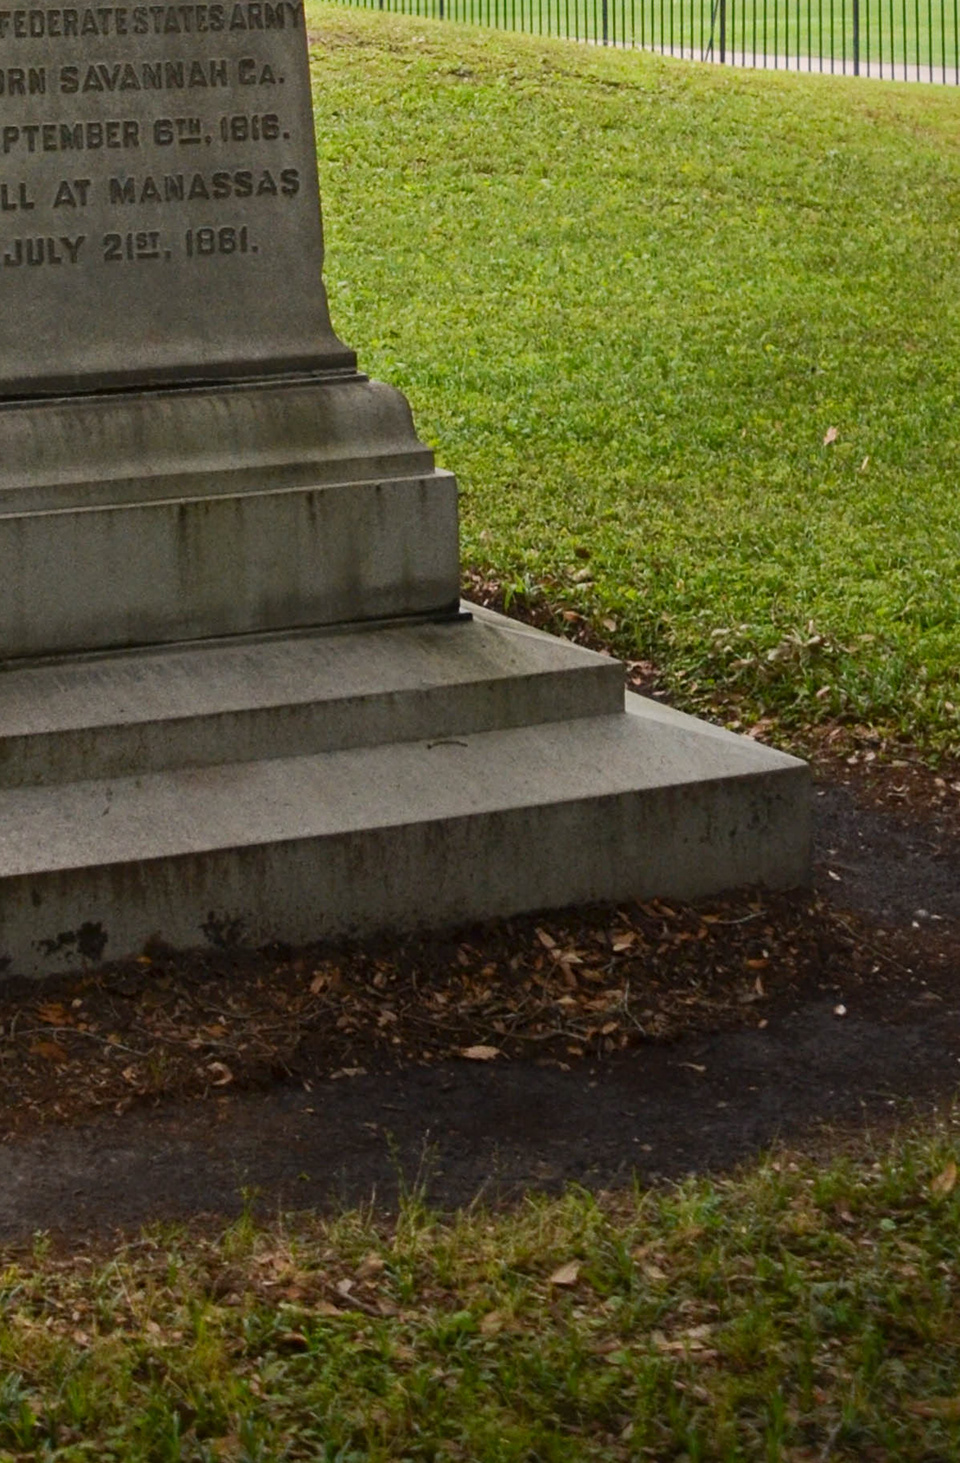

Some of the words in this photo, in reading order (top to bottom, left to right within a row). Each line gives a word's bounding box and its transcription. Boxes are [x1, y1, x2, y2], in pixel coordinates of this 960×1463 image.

[133, 3, 225, 35] STATES
[227, 1, 304, 31] ARMY
[60, 58, 228, 94] SAVANNAH
[52, 178, 92, 209] AT
[109, 168, 301, 205] MANASSAS
[3, 236, 85, 267] JULY
